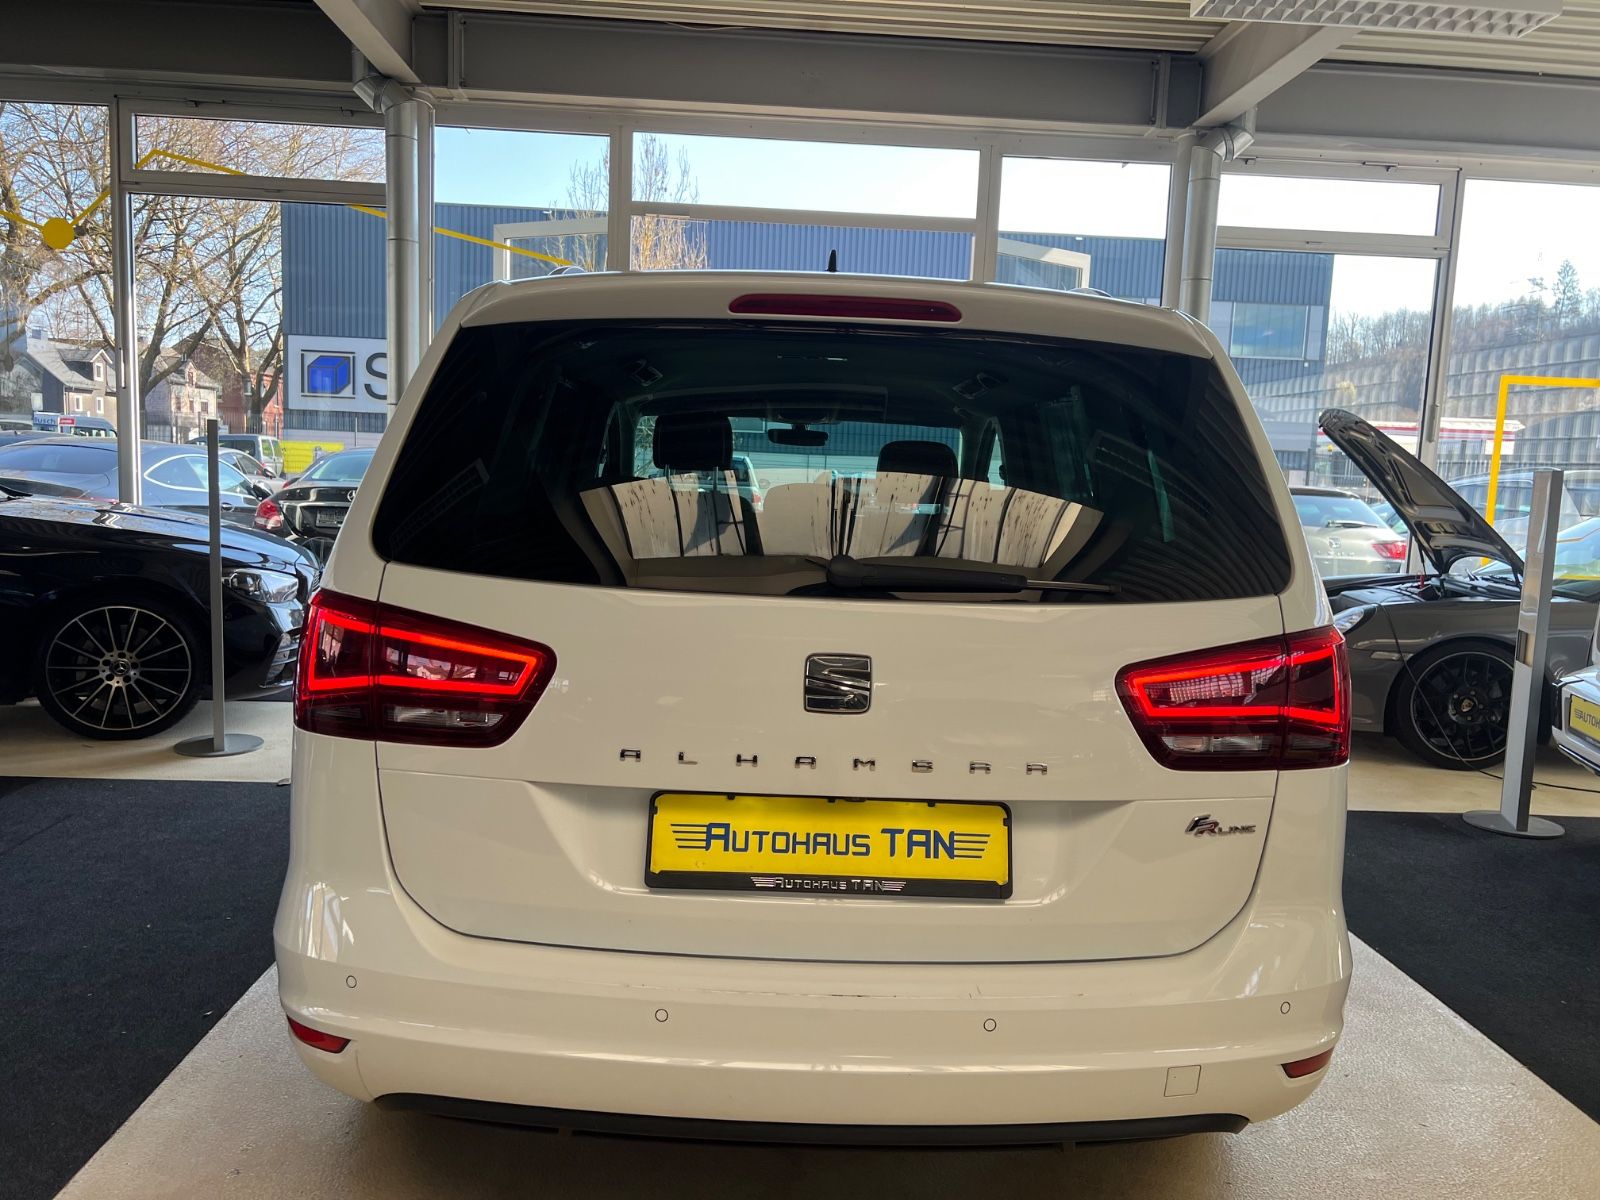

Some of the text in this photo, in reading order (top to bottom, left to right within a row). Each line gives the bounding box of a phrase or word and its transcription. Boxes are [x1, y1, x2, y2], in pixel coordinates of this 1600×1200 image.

[620, 748, 1048, 776] ALHAMBRA
[704, 822, 955, 860] AUTOHAUS TAN
[851, 879, 885, 892] TAN
